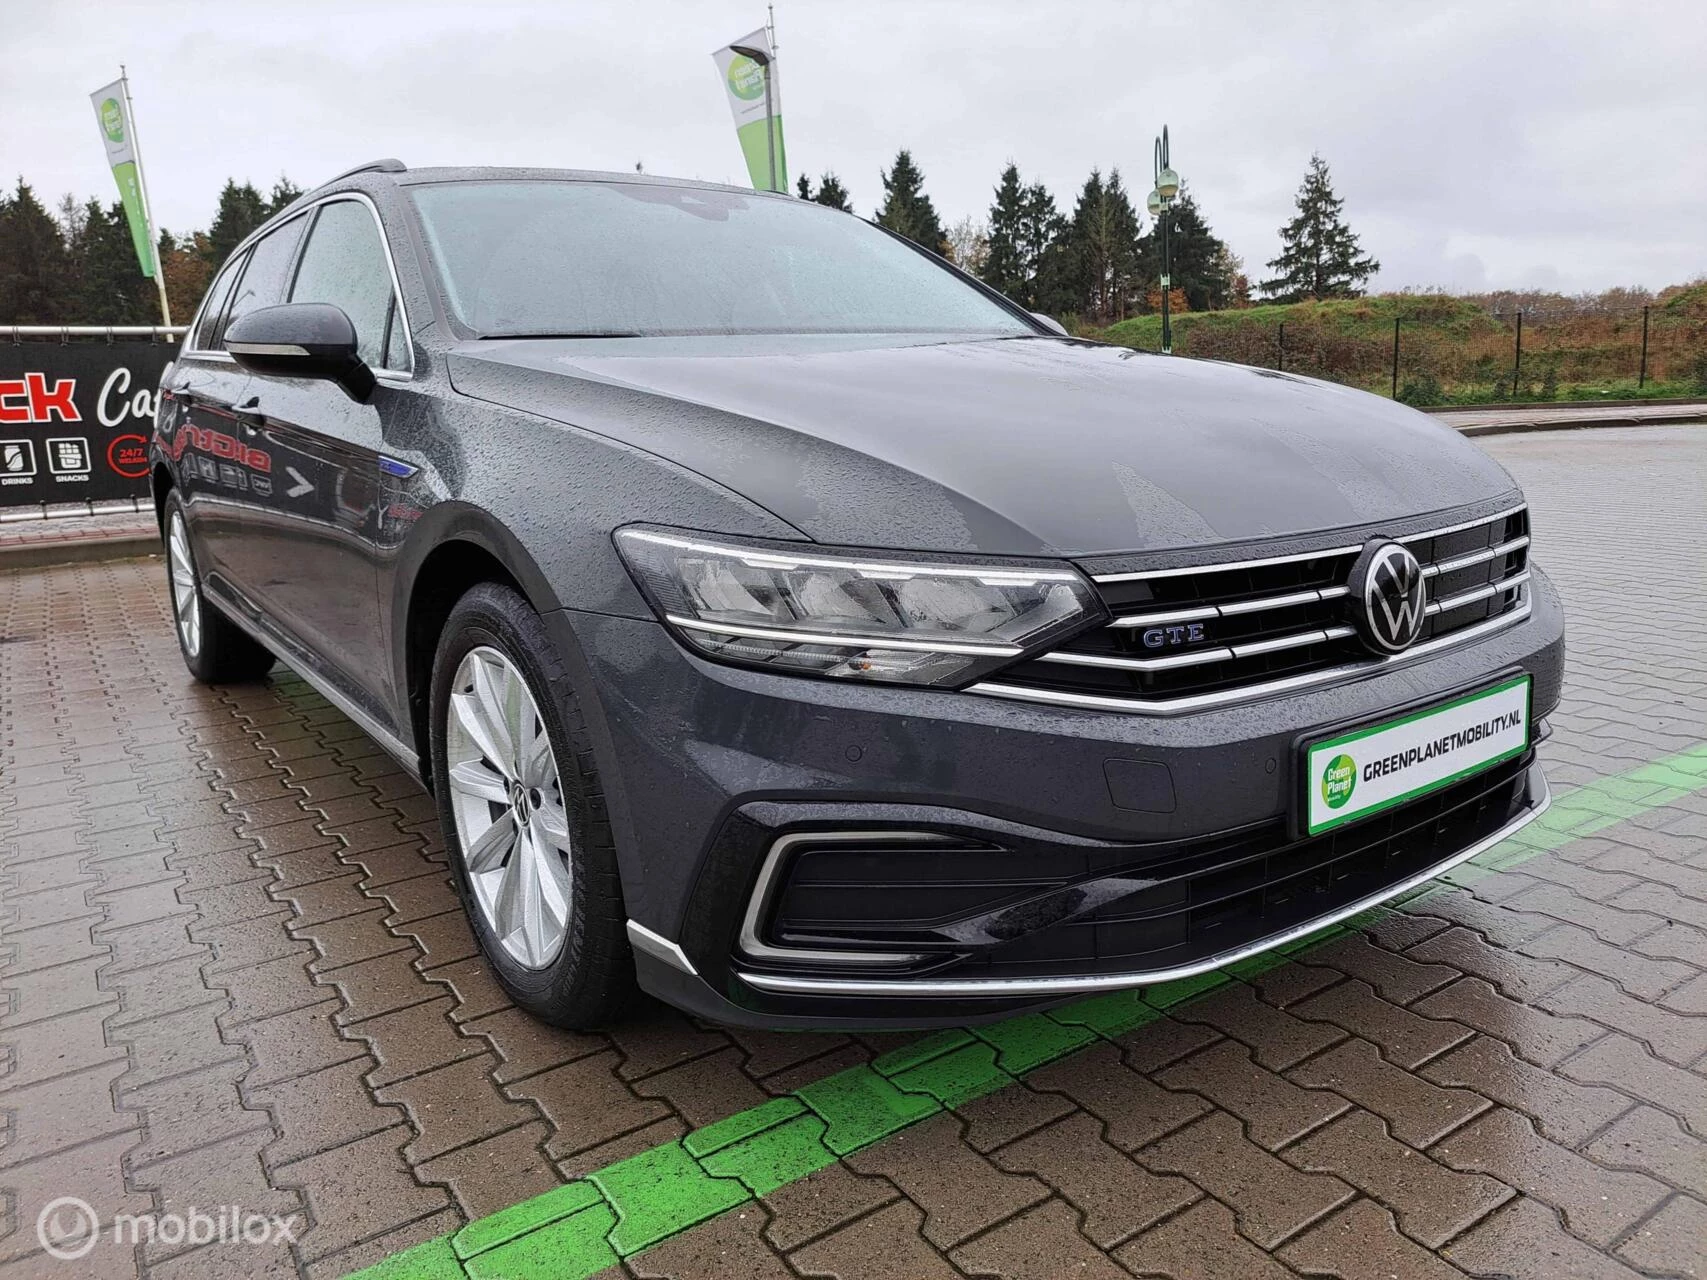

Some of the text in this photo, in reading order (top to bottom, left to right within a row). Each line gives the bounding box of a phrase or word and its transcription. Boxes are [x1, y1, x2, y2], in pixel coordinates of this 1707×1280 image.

[119, 447, 144, 458] 24/7
[1, 477, 34, 486] DRINKS
[55, 474, 90, 483] SNACKS
[1143, 623, 1205, 648] GTE
[1363, 709, 1521, 782] GREENPLANETMOBILITY.NL
[1327, 766, 1351, 781] Green
[1327, 776, 1352, 795] Planet
